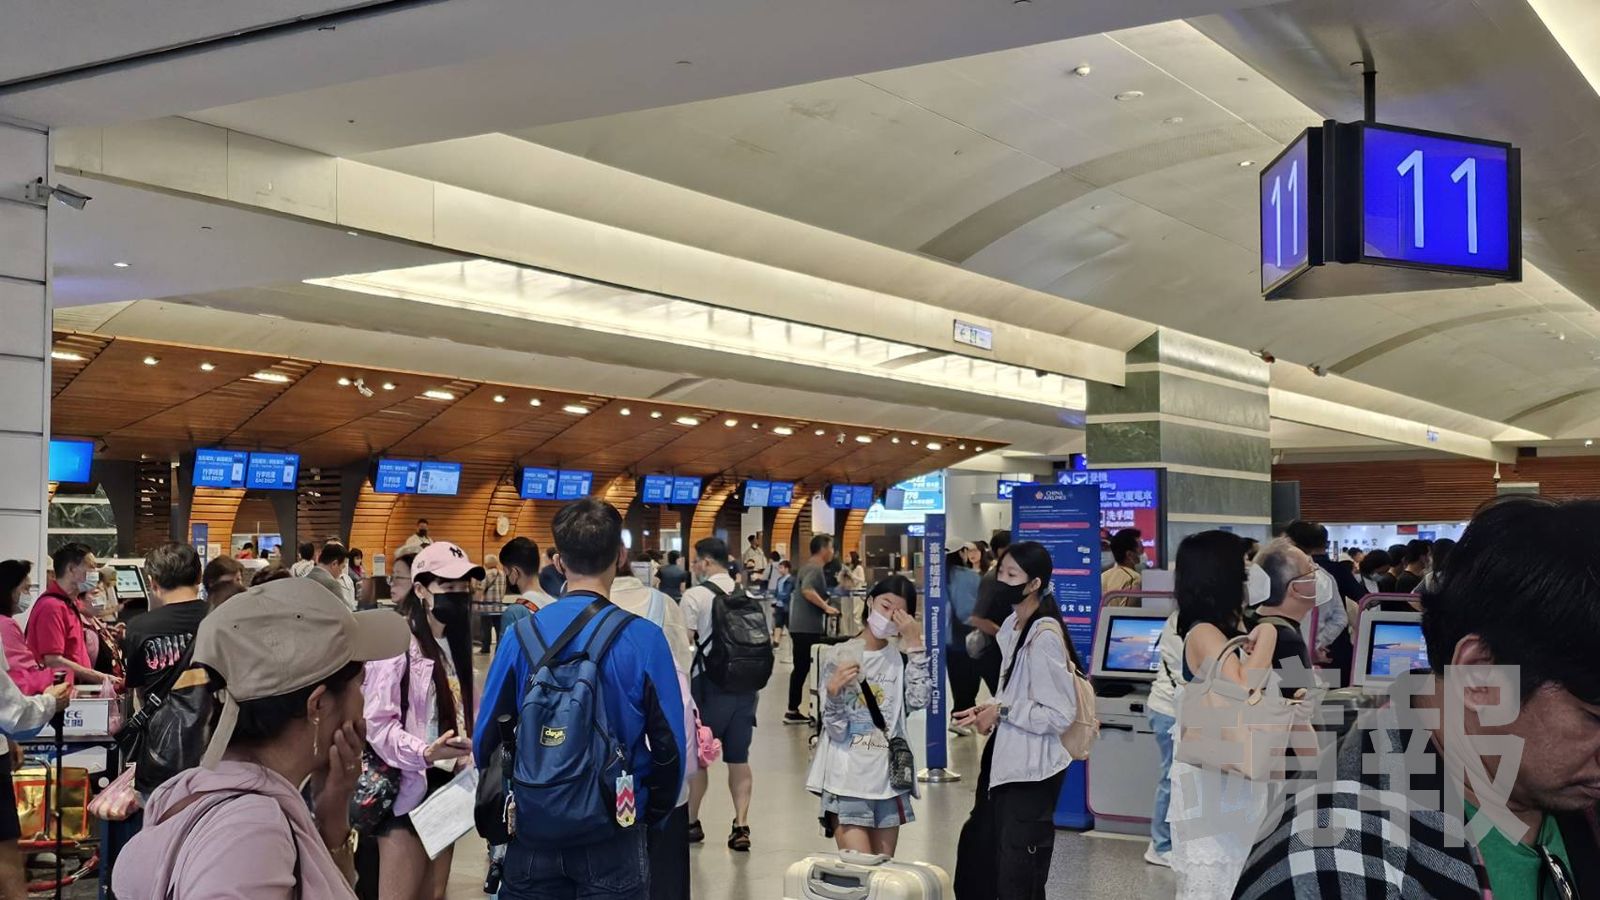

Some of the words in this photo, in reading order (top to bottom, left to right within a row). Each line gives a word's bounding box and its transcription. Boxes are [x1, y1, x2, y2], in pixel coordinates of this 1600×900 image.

[1271, 159, 1298, 268] 11
[1396, 149, 1478, 255] 11
[931, 606, 940, 646] Premium
[931, 648, 940, 688] Economy
[932, 690, 941, 715] Class
